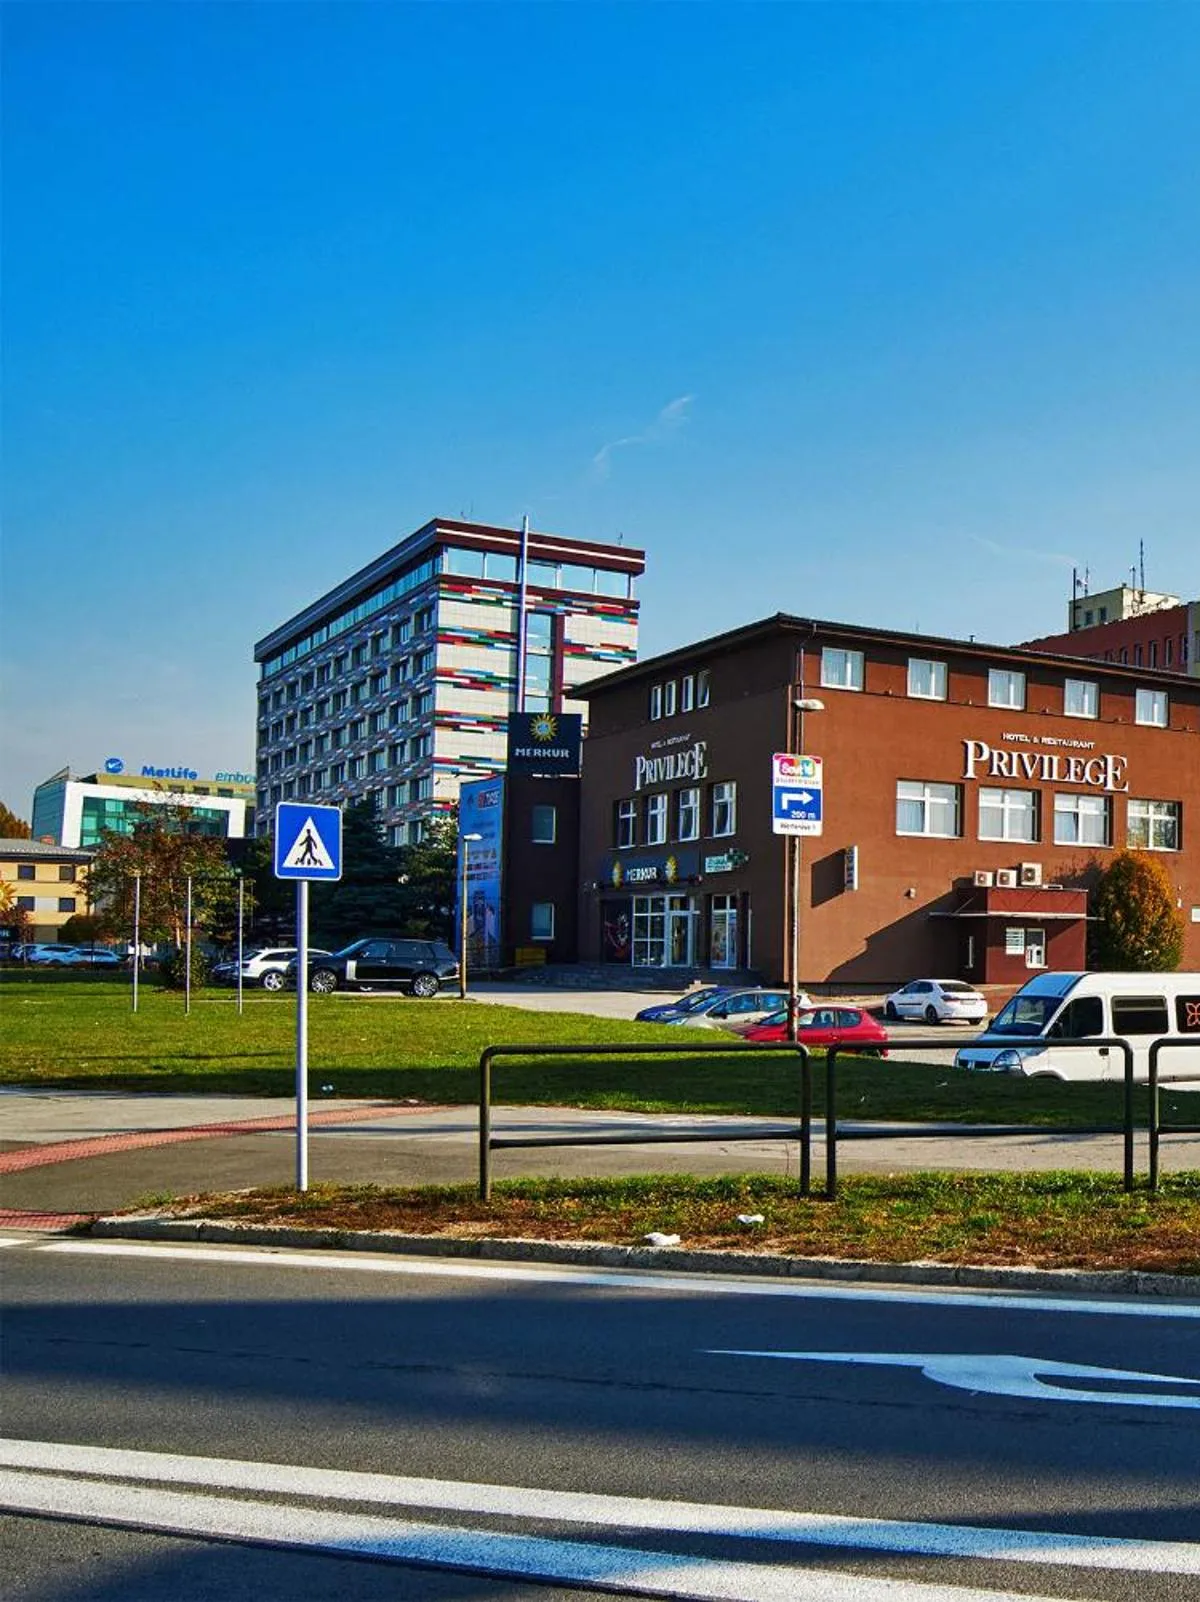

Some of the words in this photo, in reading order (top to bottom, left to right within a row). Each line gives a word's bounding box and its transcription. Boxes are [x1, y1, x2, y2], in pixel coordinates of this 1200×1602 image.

[1002, 732, 1031, 744] HOTEL
[1041, 737, 1095, 750] RESTAURANT
[514, 748, 570, 758] MERKUR
[141, 765, 198, 781] MetLife
[634, 741, 708, 792] PRIVILEGE
[962, 739, 1129, 792] PRIVILEGE
